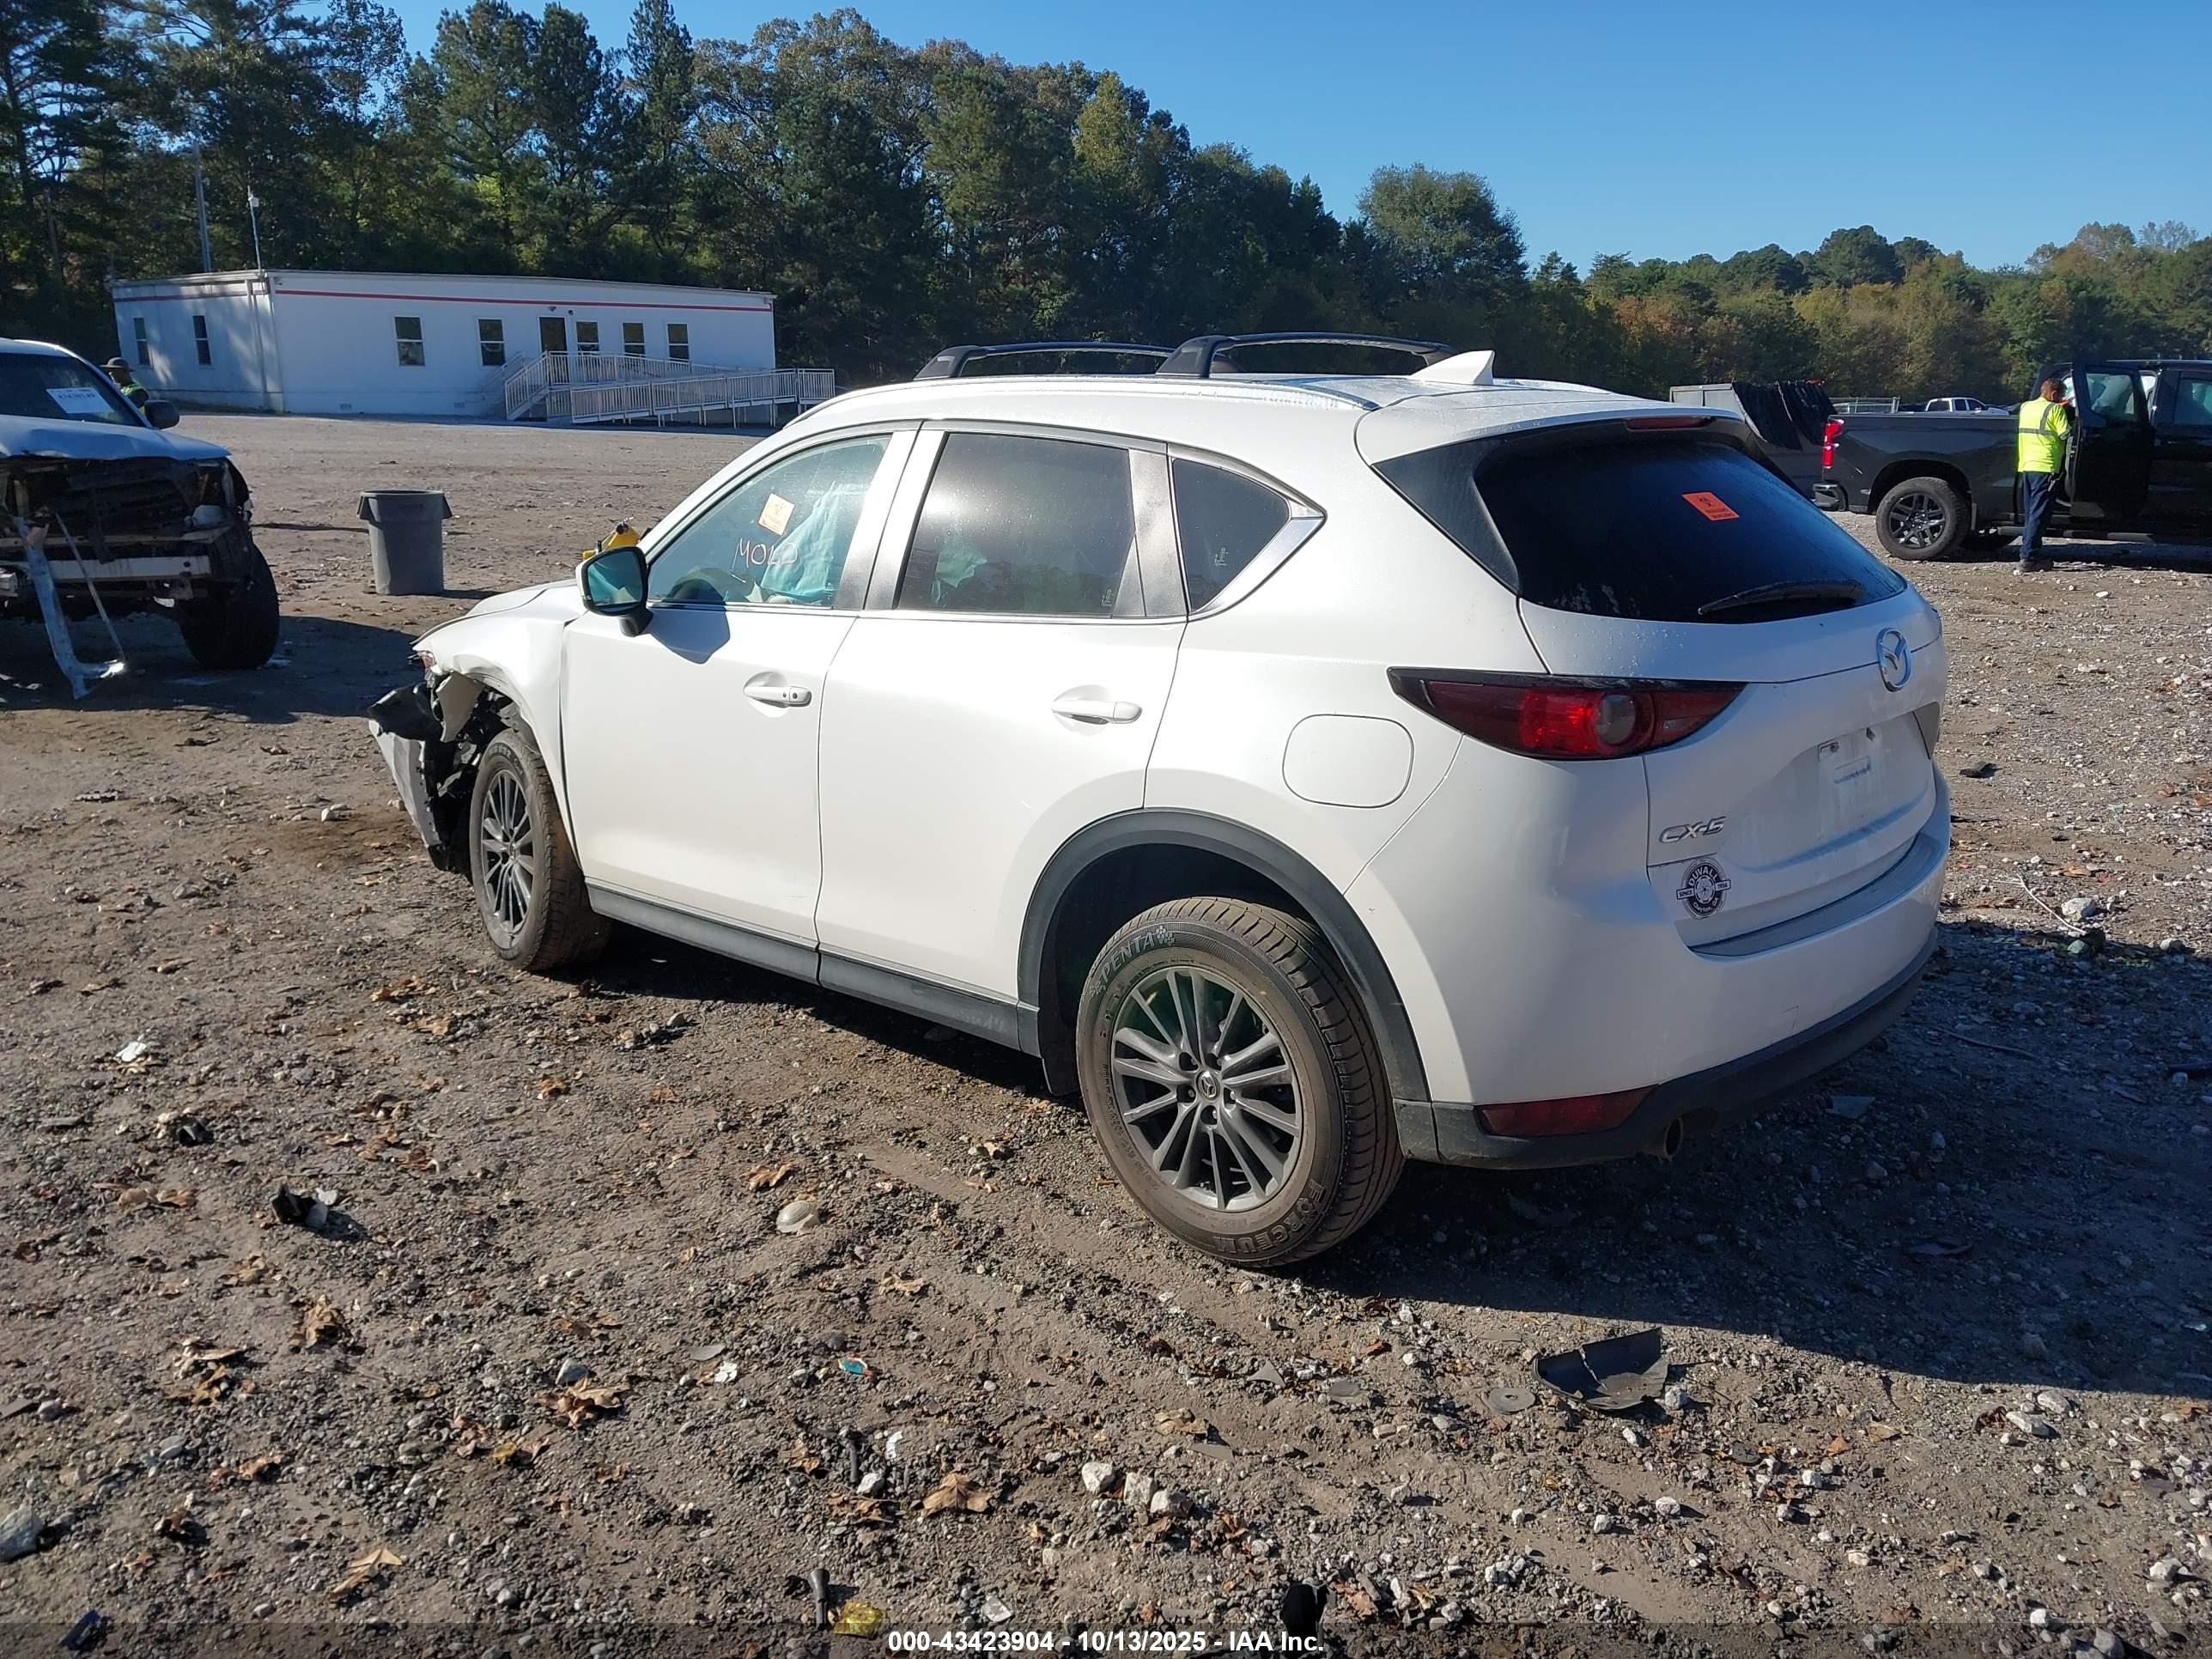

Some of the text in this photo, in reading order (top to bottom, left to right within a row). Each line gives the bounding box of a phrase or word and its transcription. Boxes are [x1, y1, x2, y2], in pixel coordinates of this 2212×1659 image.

[1659, 816, 1727, 843] CX-5
[1688, 866, 1718, 886] DUVALL
[1100, 932, 1155, 983] PENTA
[1213, 1178, 1326, 1254] FORCEUM
